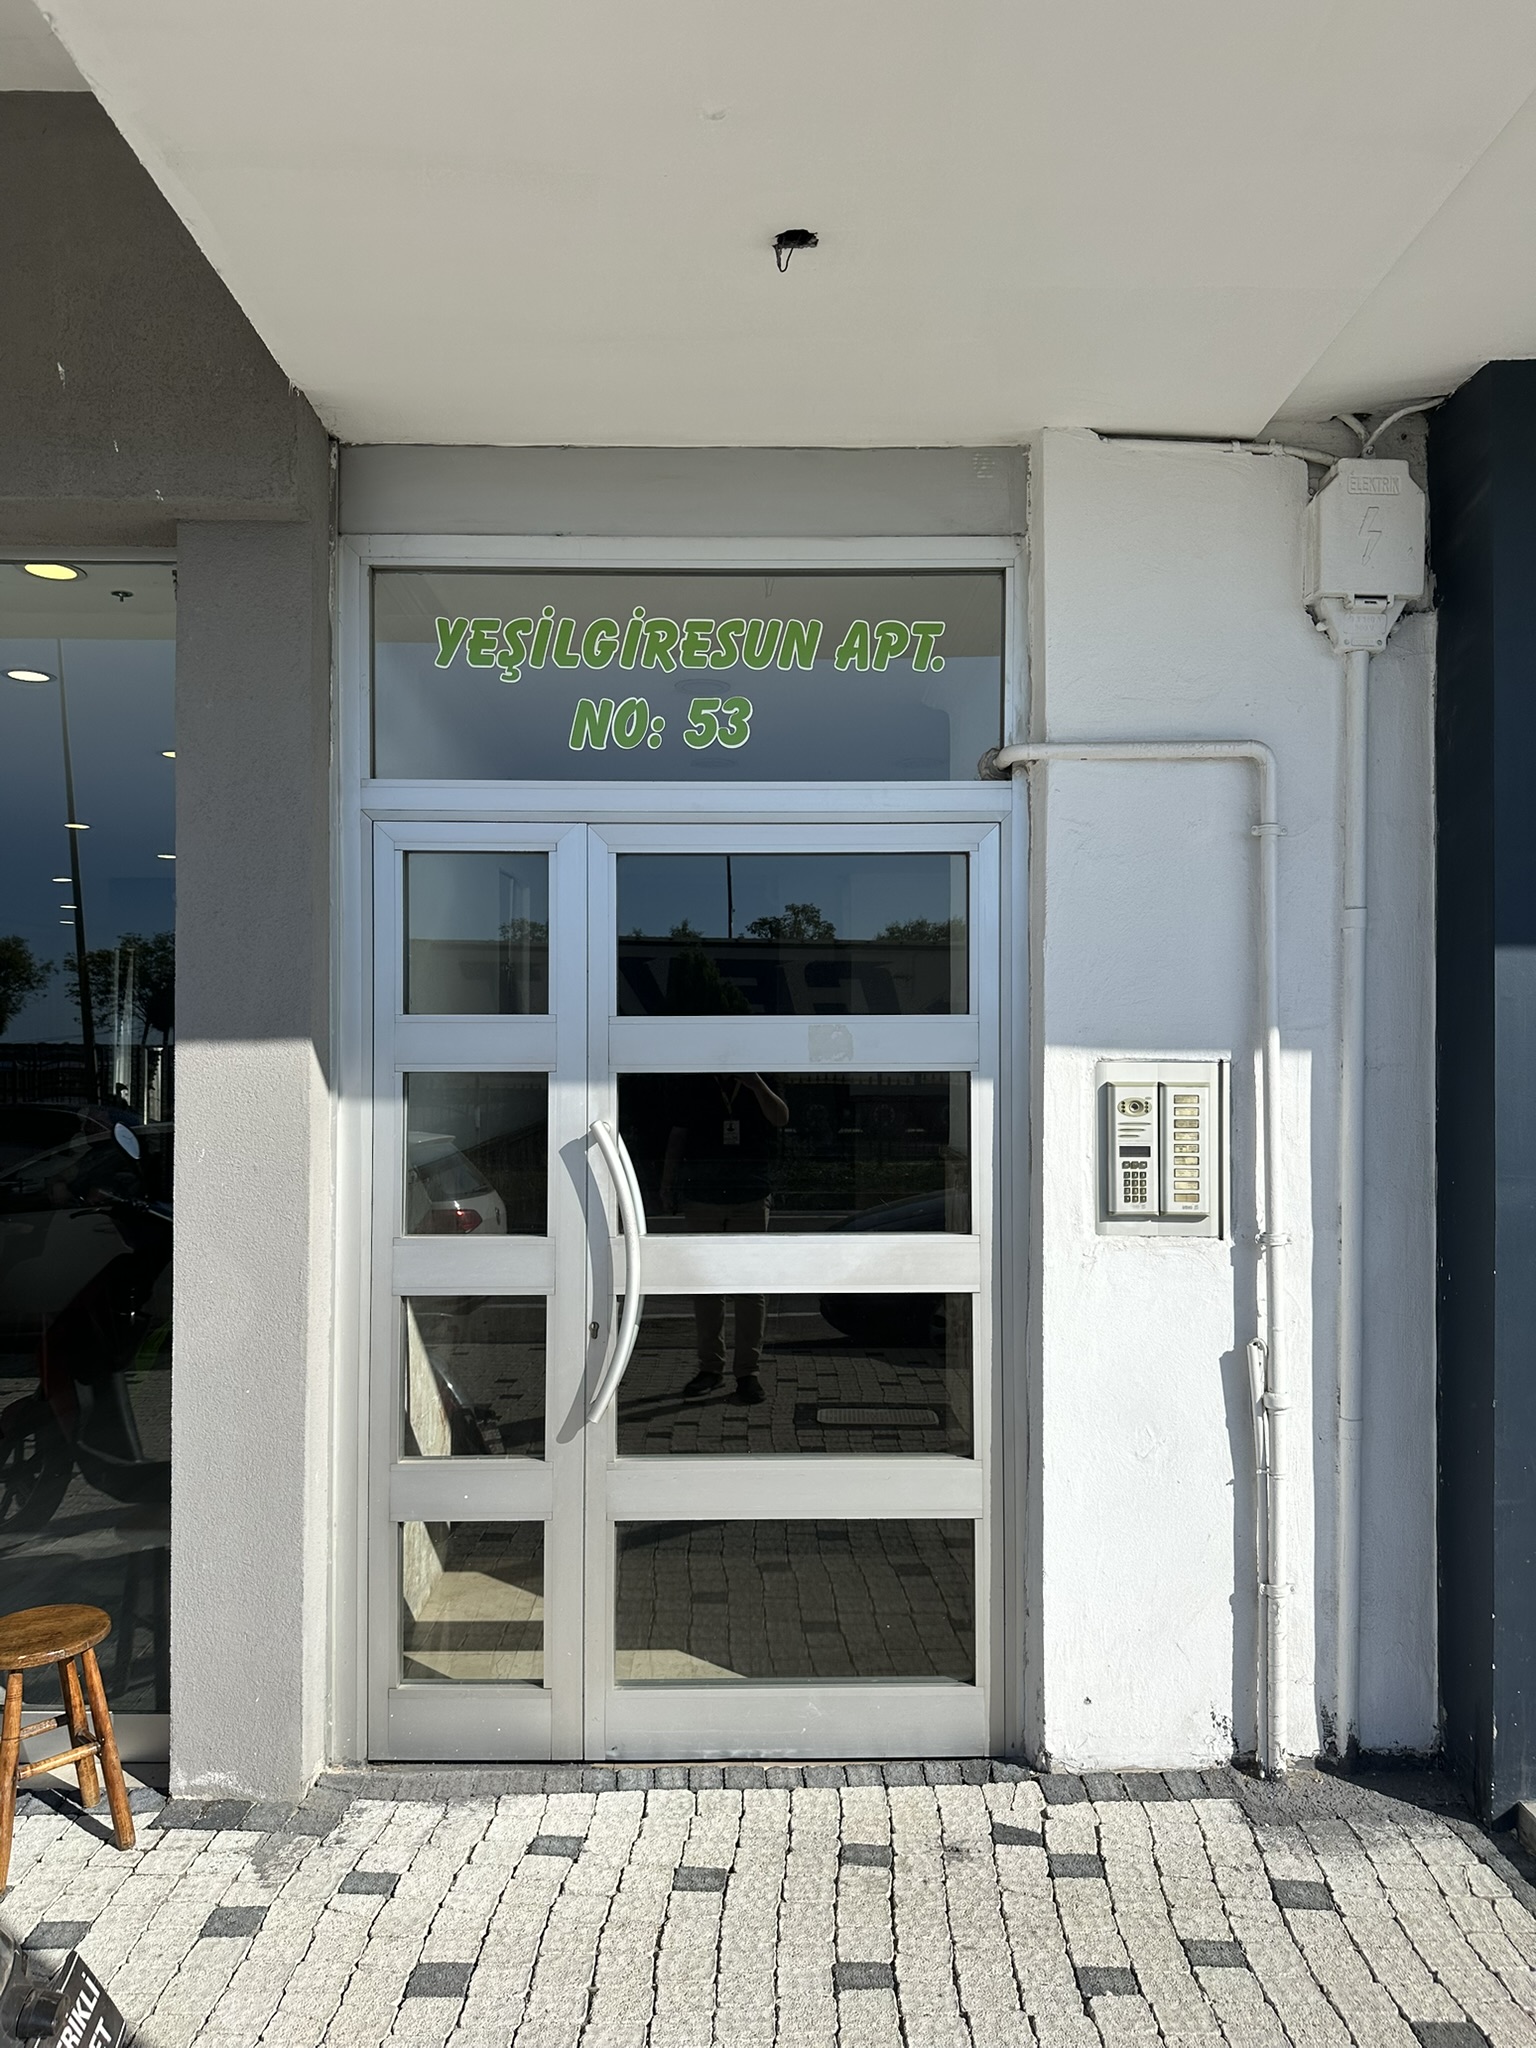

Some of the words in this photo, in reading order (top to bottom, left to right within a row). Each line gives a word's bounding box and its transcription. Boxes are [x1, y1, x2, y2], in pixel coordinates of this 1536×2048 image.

[434, 605, 823, 683] YEŞİLGİRESUN
[834, 619, 946, 673] APT.
[569, 697, 666, 751] NO:
[683, 696, 754, 750] 53
